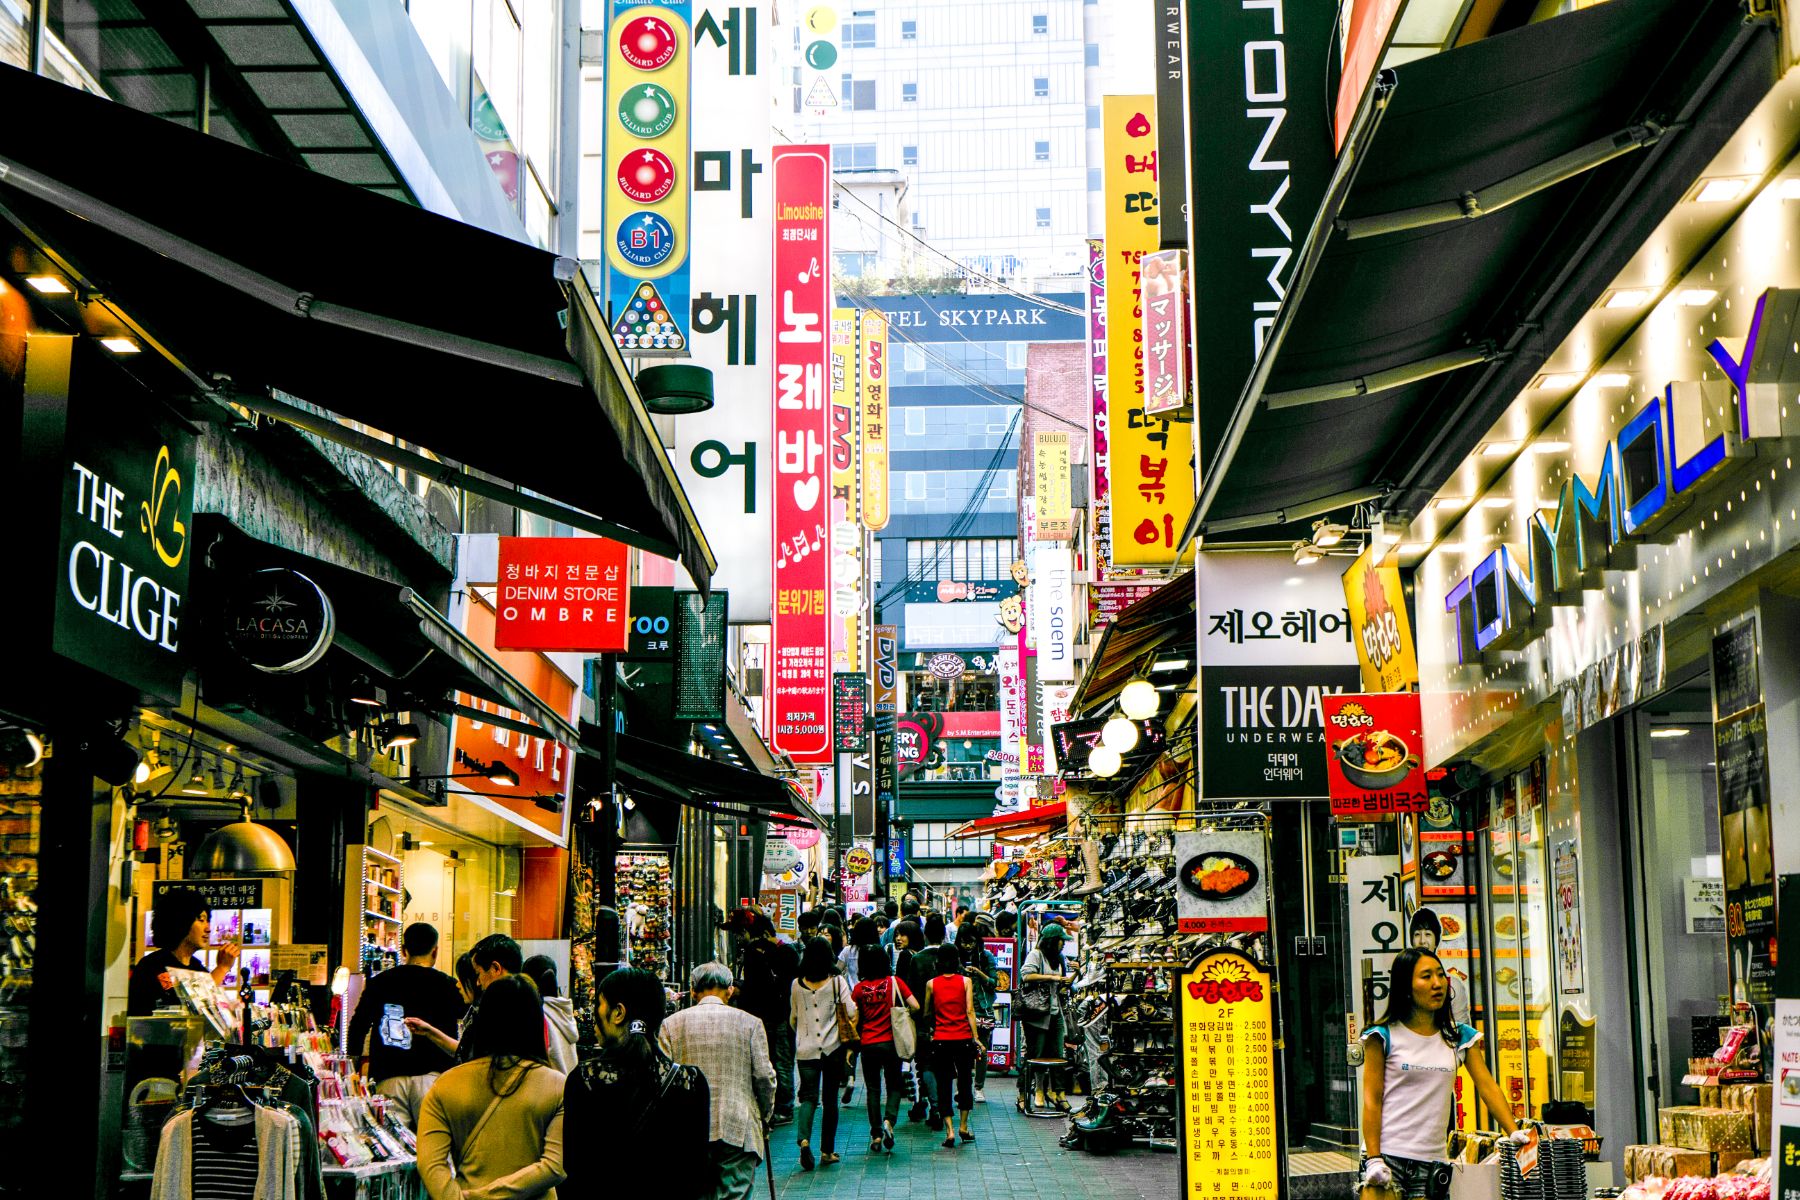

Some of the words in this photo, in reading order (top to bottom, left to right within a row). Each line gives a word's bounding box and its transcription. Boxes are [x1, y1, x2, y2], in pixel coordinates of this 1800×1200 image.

[621, 43, 653, 67] BILLIARD
[656, 45, 673, 65] CLUB
[620, 111, 652, 134] BILLIARD
[655, 112, 673, 132] CLUB
[619, 176, 651, 199] BILLIARD
[654, 177, 672, 197] CLUB
[777, 202, 823, 220] Limousine
[631, 230, 660, 248] B1
[618, 240, 651, 263] BILLIARD
[653, 241, 671, 262] CLUB
[1122, 250, 1147, 264] TE
[939, 309, 1048, 327] SKYPARK
[1151, 299, 1174, 397] マッサージ
[870, 341, 882, 379] DVD
[833, 404, 851, 471] DVD
[1128, 407, 1174, 548] 떡볶이
[1445, 287, 1770, 665] TONYMOLY
[72, 461, 126, 539] THE
[1040, 520, 1068, 531] 부르조
[506, 563, 558, 581] 청바지
[565, 563, 619, 581] 전문샵
[505, 586, 557, 601] DENIM
[563, 586, 618, 601] STORE
[1050, 569, 1066, 602] the
[68, 539, 181, 652] CLIGE
[778, 589, 825, 615] 분위기캡
[503, 606, 617, 622] OMBRE
[236, 617, 309, 633] LACASA
[1050, 606, 1065, 660] saem
[1208, 608, 1352, 644] 제오헤어
[647, 640, 669, 650] 크루
[875, 637, 896, 690] DVD
[1221, 686, 1276, 728] THE
[1282, 685, 1344, 728] DA
[786, 712, 815, 722] 최저가격
[1268, 753, 1298, 767] 더데이
[1263, 767, 1303, 781] 언더웨어
[1362, 791, 1428, 812] 냄비국수
[849, 856, 869, 865] DVD
[238, 885, 256, 895] 매장
[780, 894, 796, 930] ミナミ
[1218, 1008, 1234, 1018] 2F
[1190, 1022, 1233, 1031] 명화당김밥
[1190, 1034, 1234, 1043] 참치김밥
[1193, 1139, 1237, 1149] 김치우동
